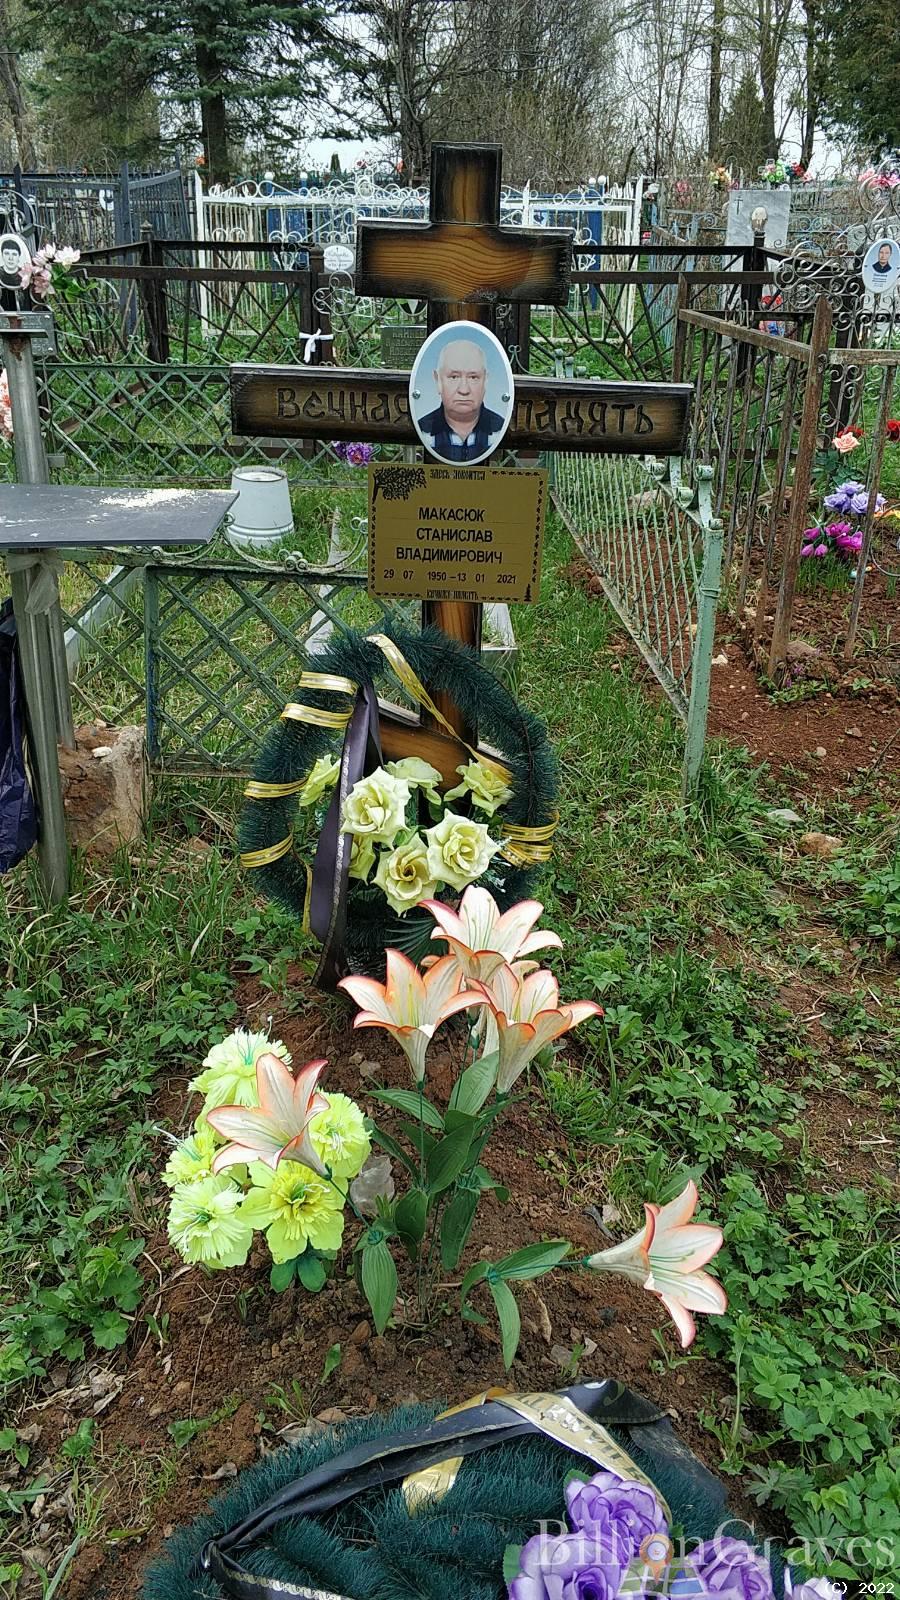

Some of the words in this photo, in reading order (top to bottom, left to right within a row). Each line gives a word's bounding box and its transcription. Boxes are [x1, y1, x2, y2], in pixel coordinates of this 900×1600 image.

[418, 507, 486, 523] МАКАСЮК
[416, 527, 493, 543] СТАНИСЛАВ
[396, 547, 503, 564] ВЛАДИМИРОВИЧ
[383, 569, 395, 579] 29
[403, 570, 414, 580] 07
[426, 571, 447, 582] 1950
[475, 573, 485, 583] 01
[496, 574, 517, 584] 2021
